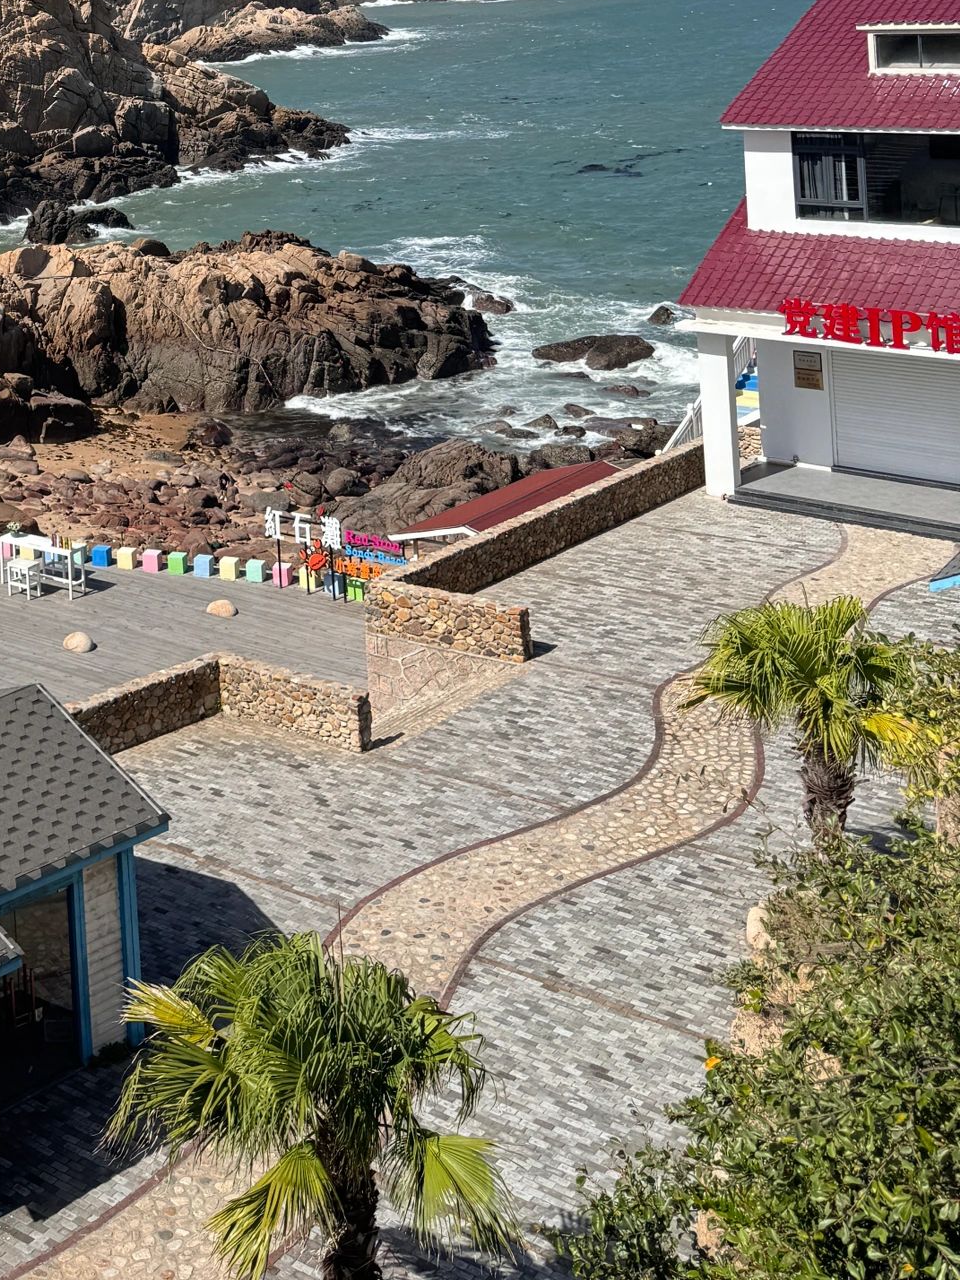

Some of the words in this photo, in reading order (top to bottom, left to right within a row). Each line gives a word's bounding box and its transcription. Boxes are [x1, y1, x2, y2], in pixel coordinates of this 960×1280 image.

[777, 297, 960, 354] 党建IP馆
[344, 529, 369, 546] Red
